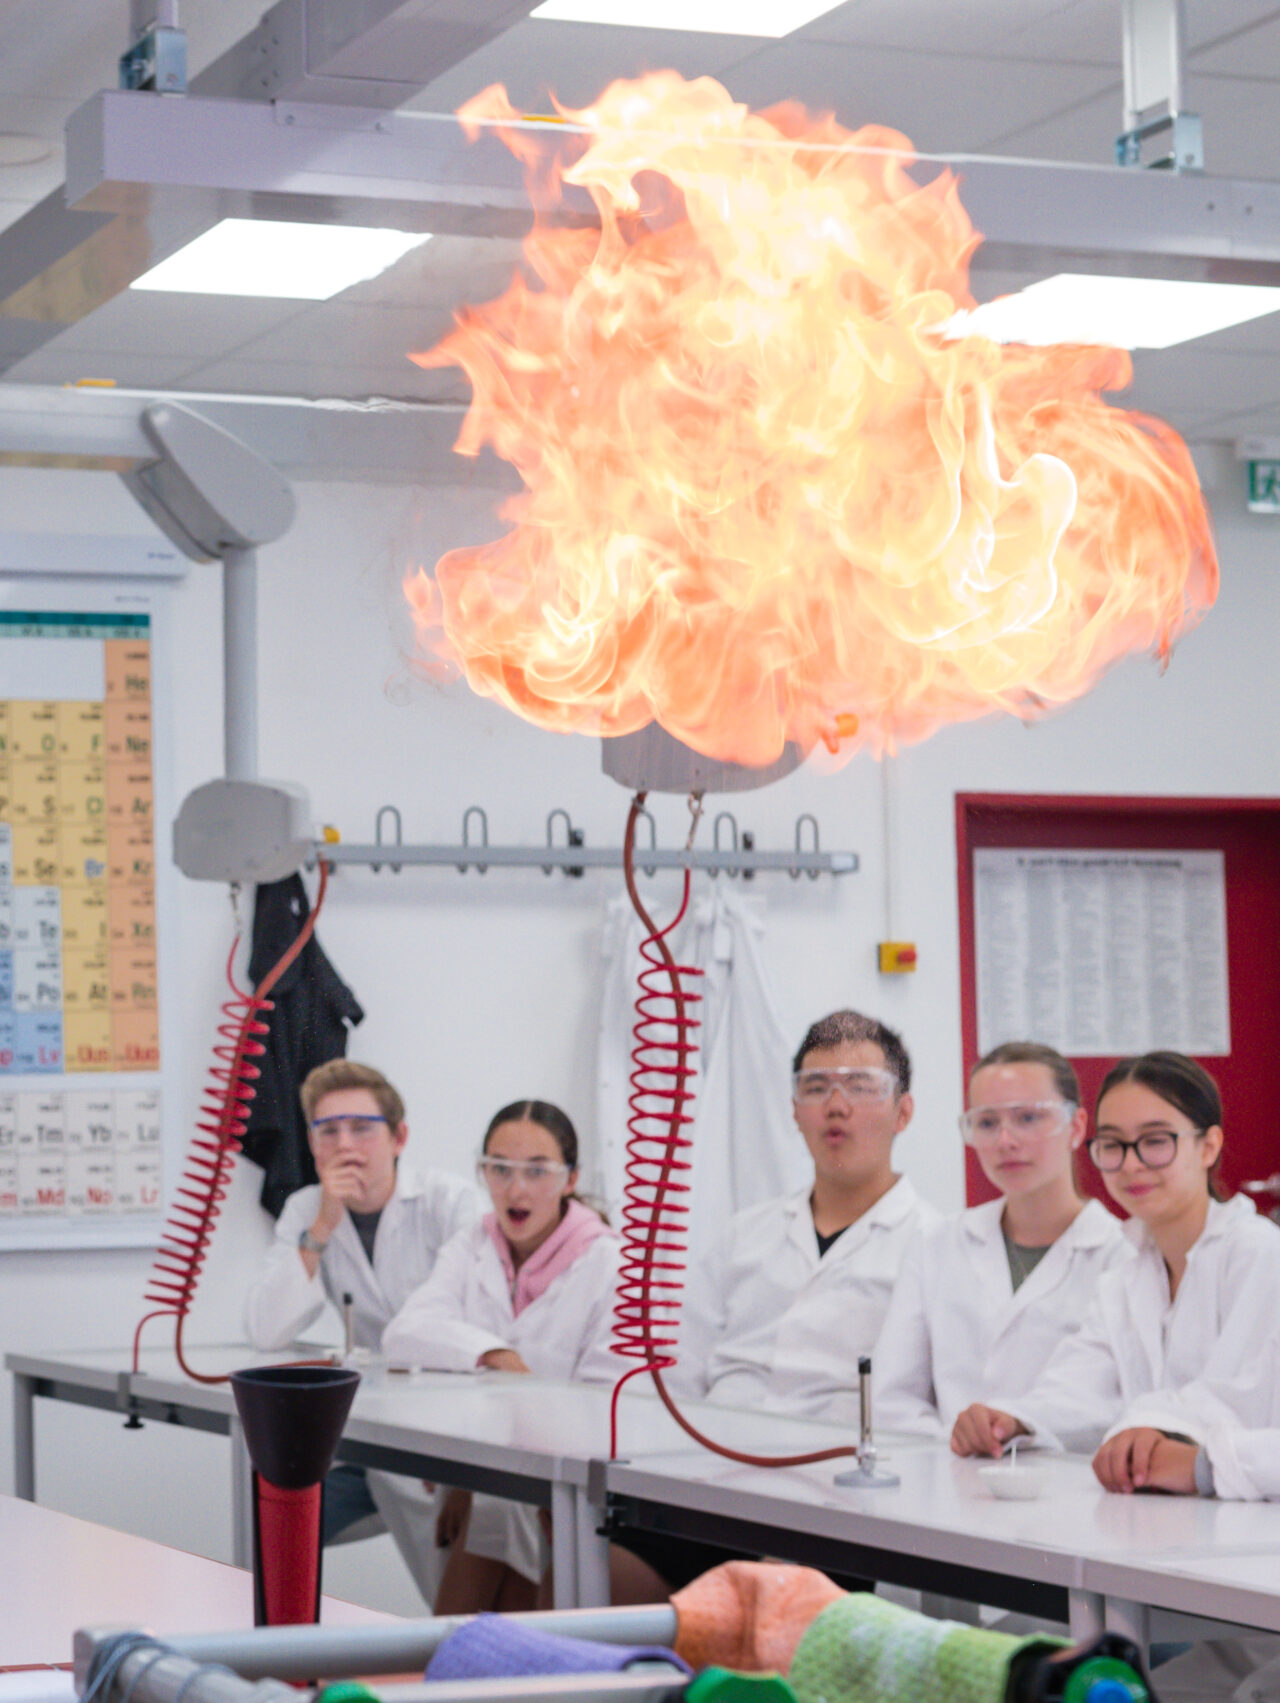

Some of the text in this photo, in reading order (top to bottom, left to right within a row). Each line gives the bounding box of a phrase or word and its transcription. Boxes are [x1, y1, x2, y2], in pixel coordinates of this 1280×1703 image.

[126, 673, 149, 691] He
[42, 734, 53, 752] O
[91, 734, 100, 752] F
[126, 734, 149, 753] Ne
[44, 797, 54, 815] S
[132, 797, 150, 815] Ar
[35, 859, 57, 877] Se
[85, 859, 104, 877] Br
[134, 859, 152, 876] Kr
[39, 921, 58, 938] Te
[38, 983, 60, 1000] Po
[89, 982, 108, 1000] At
[132, 982, 155, 1000] Rn
[39, 1046, 60, 1064] Lv
[38, 1125, 63, 1144] Tm
[88, 1124, 111, 1143] Yb
[38, 1188, 65, 1206] Md
